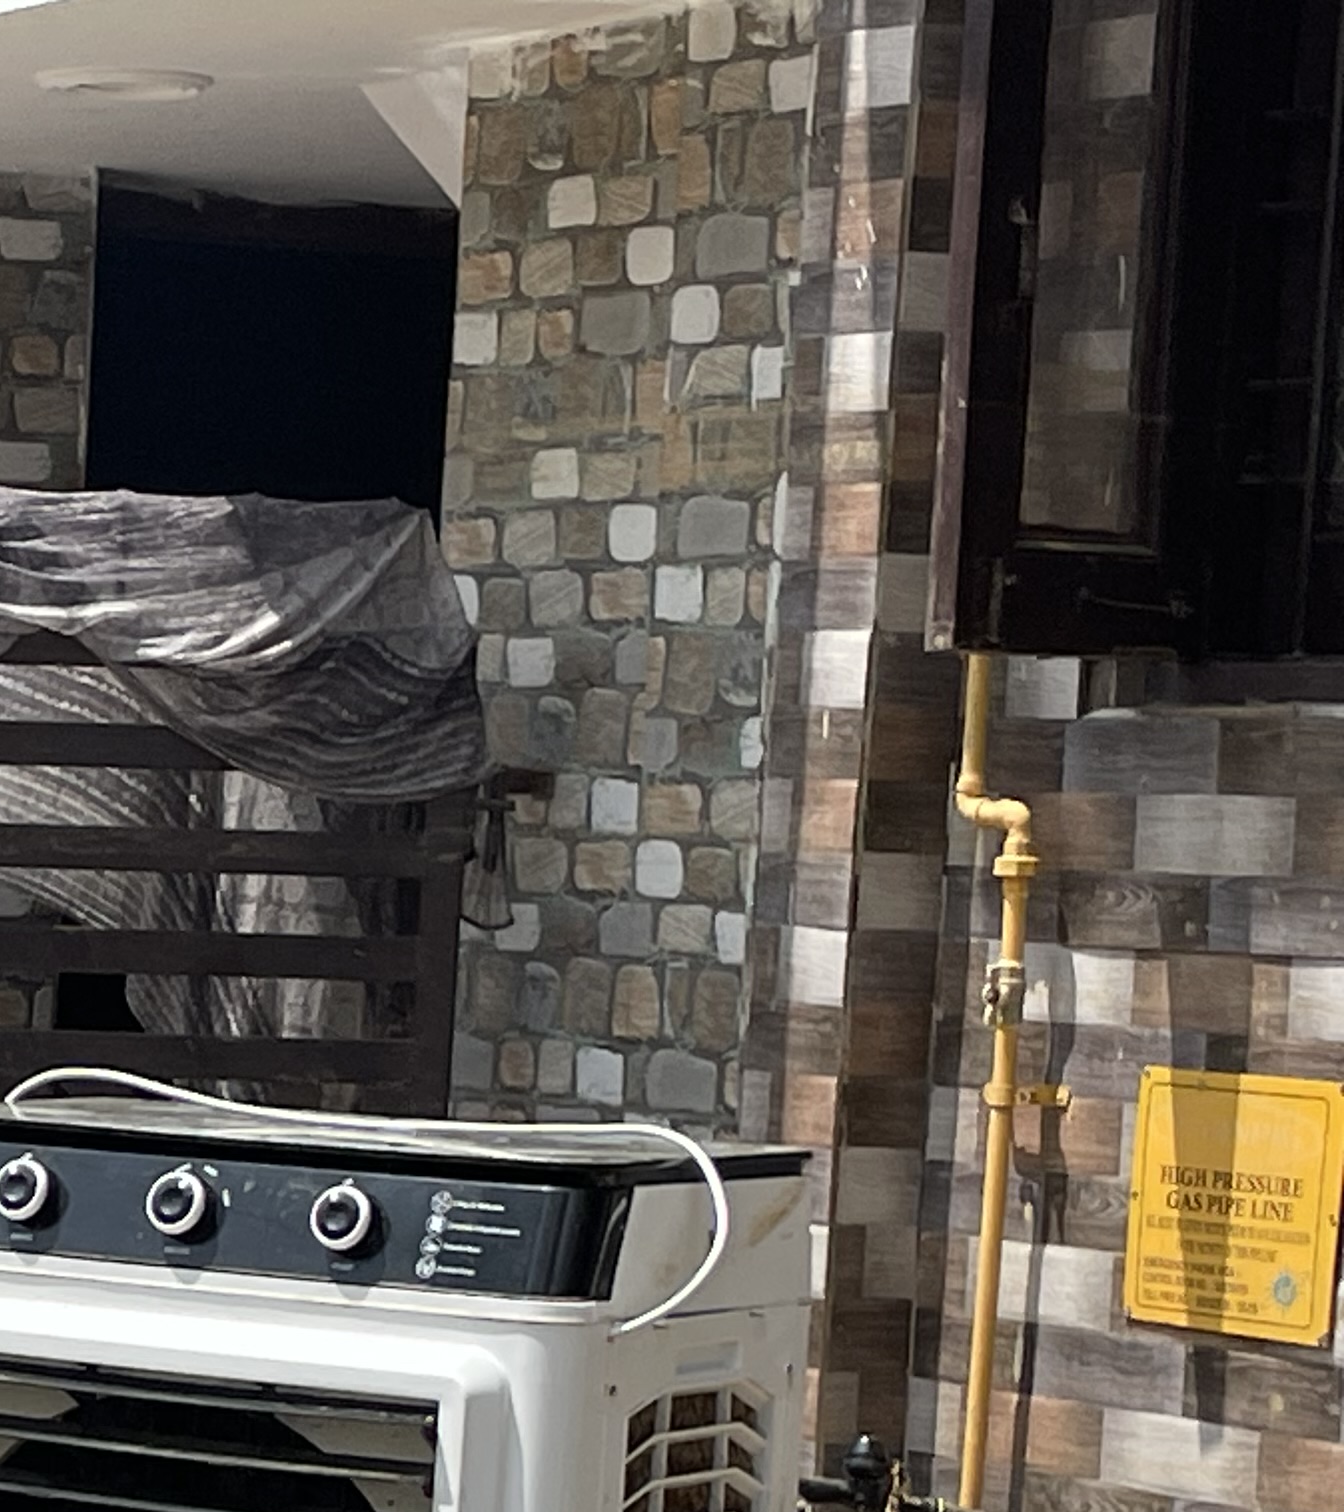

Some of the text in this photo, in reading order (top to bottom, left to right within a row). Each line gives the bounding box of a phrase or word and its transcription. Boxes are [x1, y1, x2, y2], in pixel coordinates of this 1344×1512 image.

[1160, 1165, 1303, 1198] HIGH PRESSURE
[1166, 1190, 1294, 1223] GAS PIPE LINE
